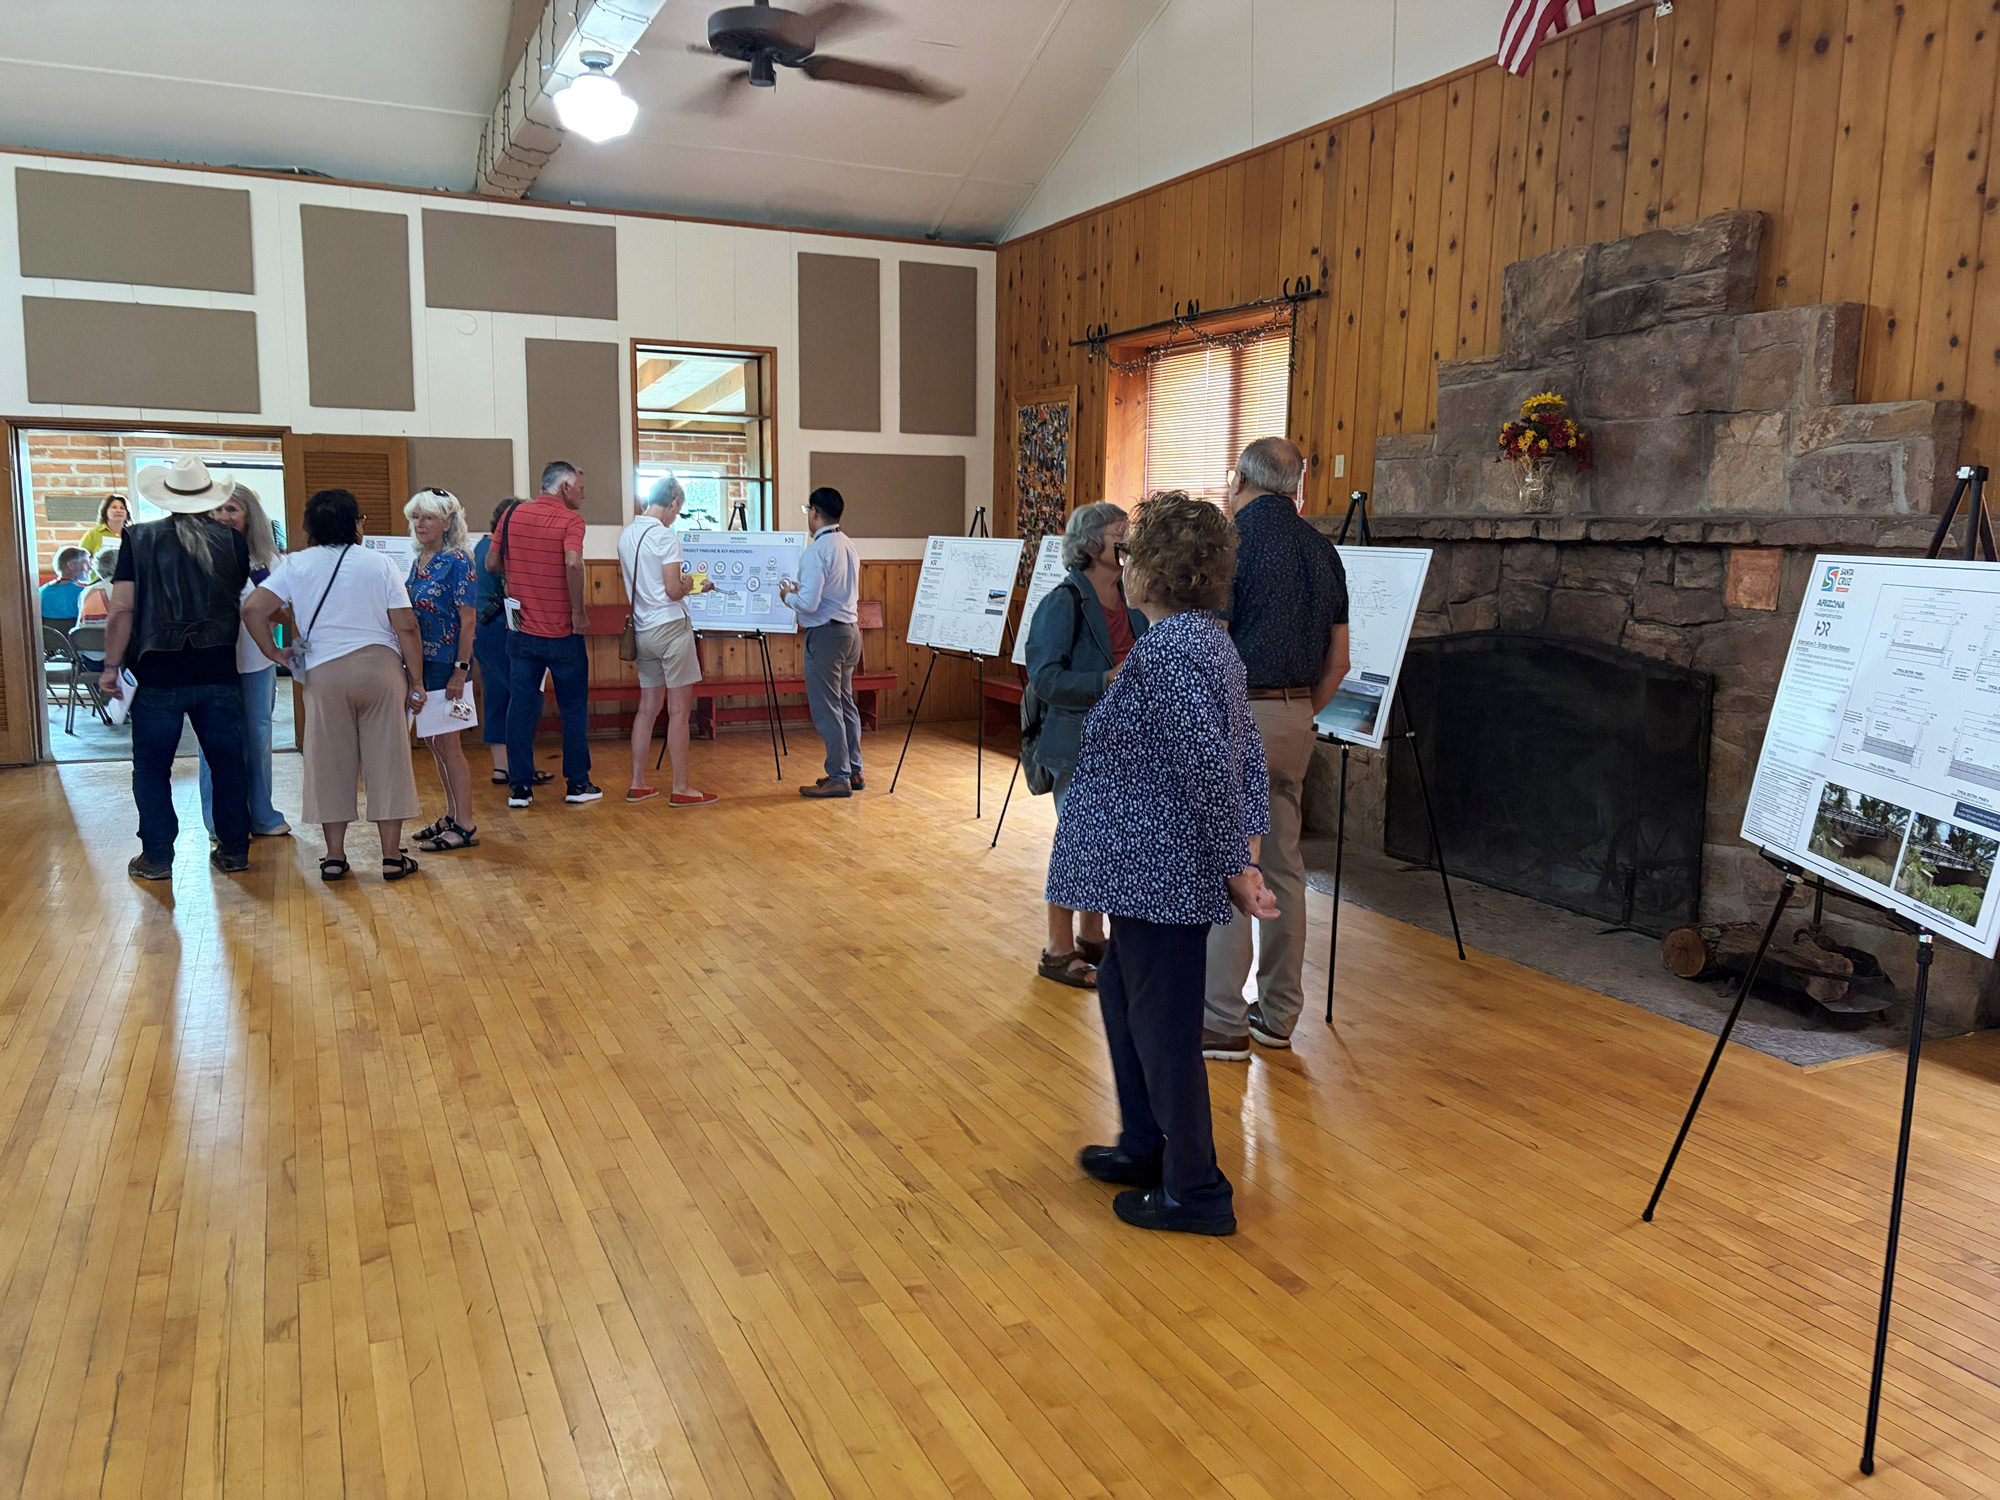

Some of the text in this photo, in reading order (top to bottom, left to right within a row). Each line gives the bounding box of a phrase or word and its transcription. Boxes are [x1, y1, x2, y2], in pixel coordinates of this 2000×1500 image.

[1840, 568, 1854, 576] SANTA
[1838, 577, 1852, 586] CRUZ
[427, 587, 442, 597] 66
[1816, 598, 1845, 609] ARIZONA
[1814, 612, 1843, 620] TRANSPORTATION
[1814, 620, 1831, 637] HDR
[423, 640, 441, 649] ROUTE
[424, 647, 438, 656] 66
